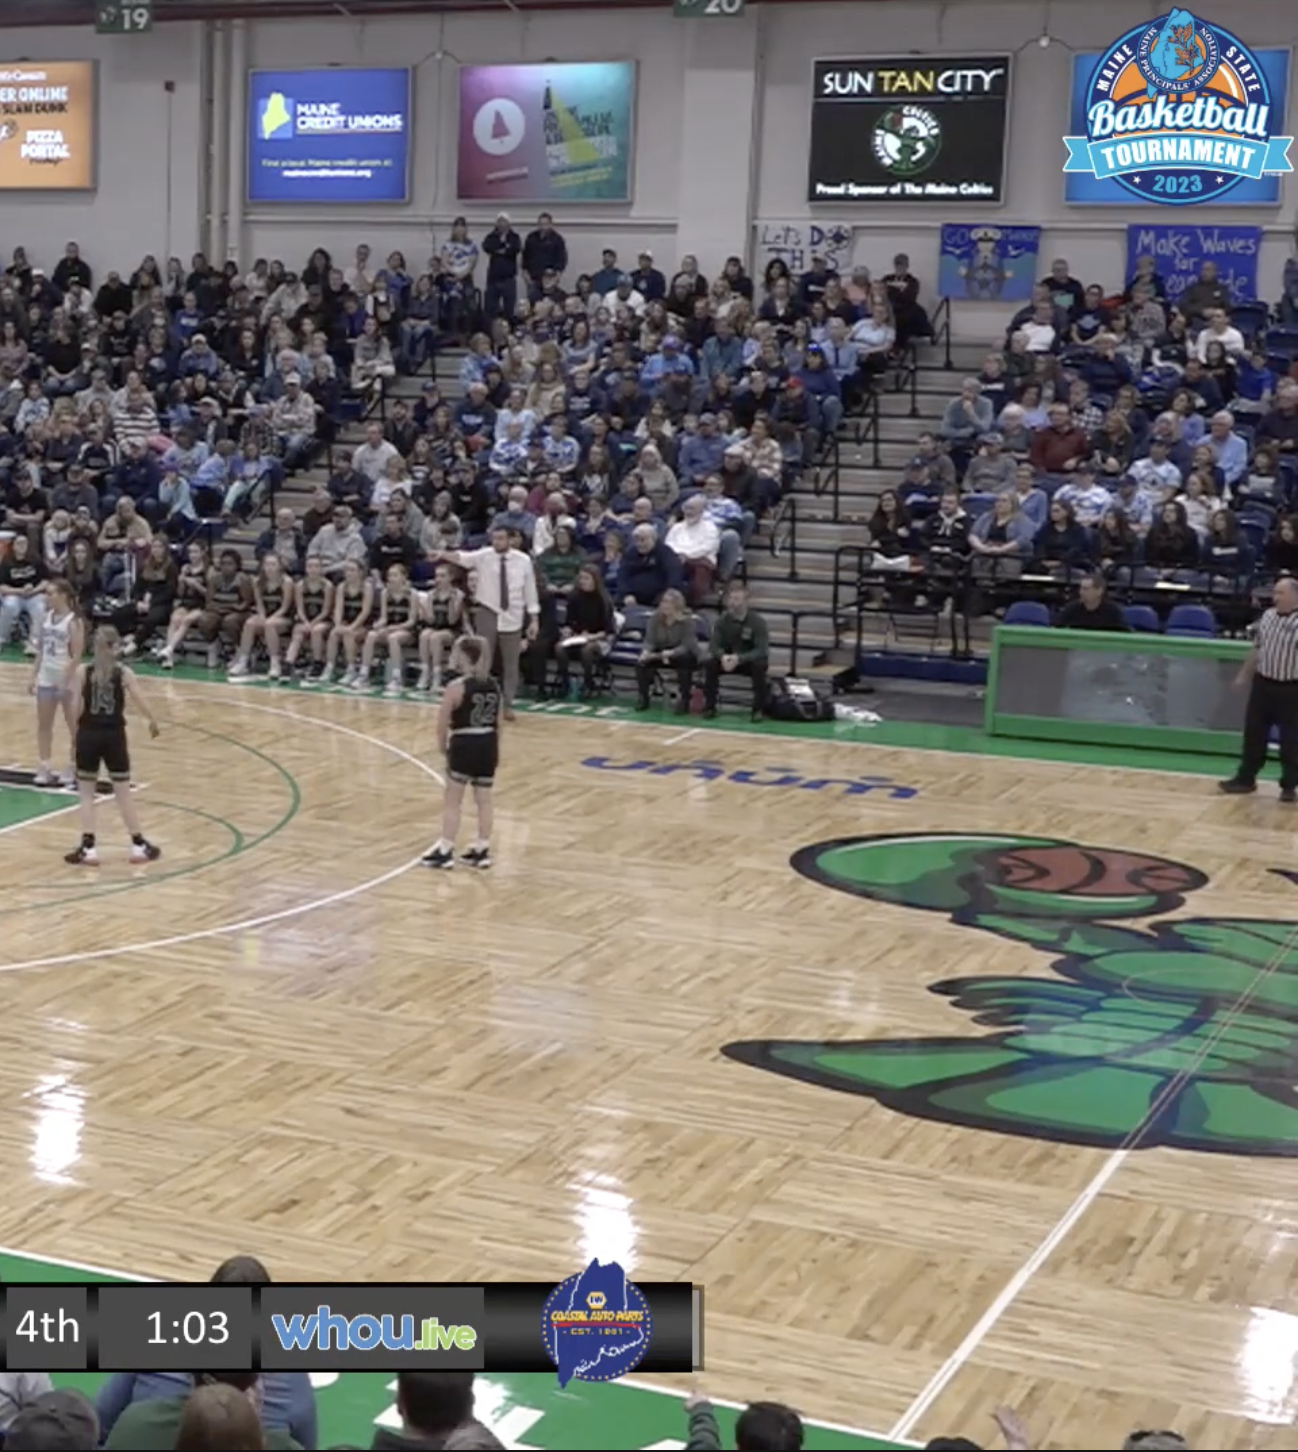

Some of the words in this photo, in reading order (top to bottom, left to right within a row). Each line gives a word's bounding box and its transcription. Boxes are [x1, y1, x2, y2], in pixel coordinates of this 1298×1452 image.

[121, 7, 149, 30] 19
[823, 71, 874, 95] SUN
[877, 69, 935, 93] TAN
[937, 67, 1004, 92] CITY
[18, 86, 68, 102] ONLINE
[296, 102, 341, 116] MAINE
[296, 116, 347, 130] CREDIT
[349, 114, 403, 129] UNIONS
[1135, 229, 1191, 257] Make
[1196, 227, 1256, 255] Waves
